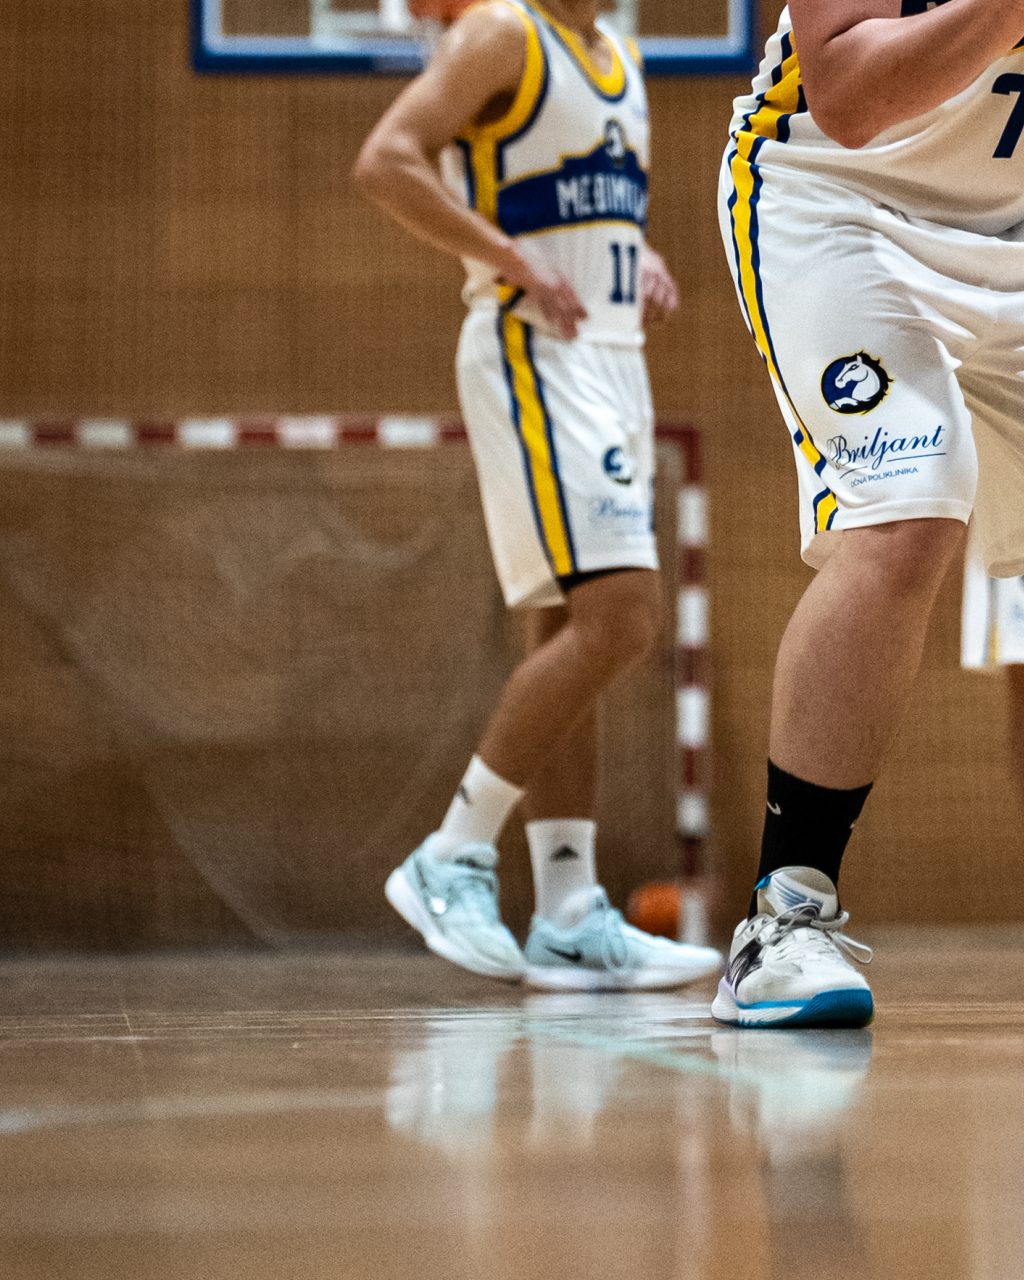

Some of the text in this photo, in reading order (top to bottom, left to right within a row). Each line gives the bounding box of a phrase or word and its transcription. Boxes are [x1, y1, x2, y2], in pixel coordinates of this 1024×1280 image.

[609, 243, 636, 303] 11
[827, 425, 945, 470] Briljant
[868, 467, 918, 482] POLIKLINIKA
